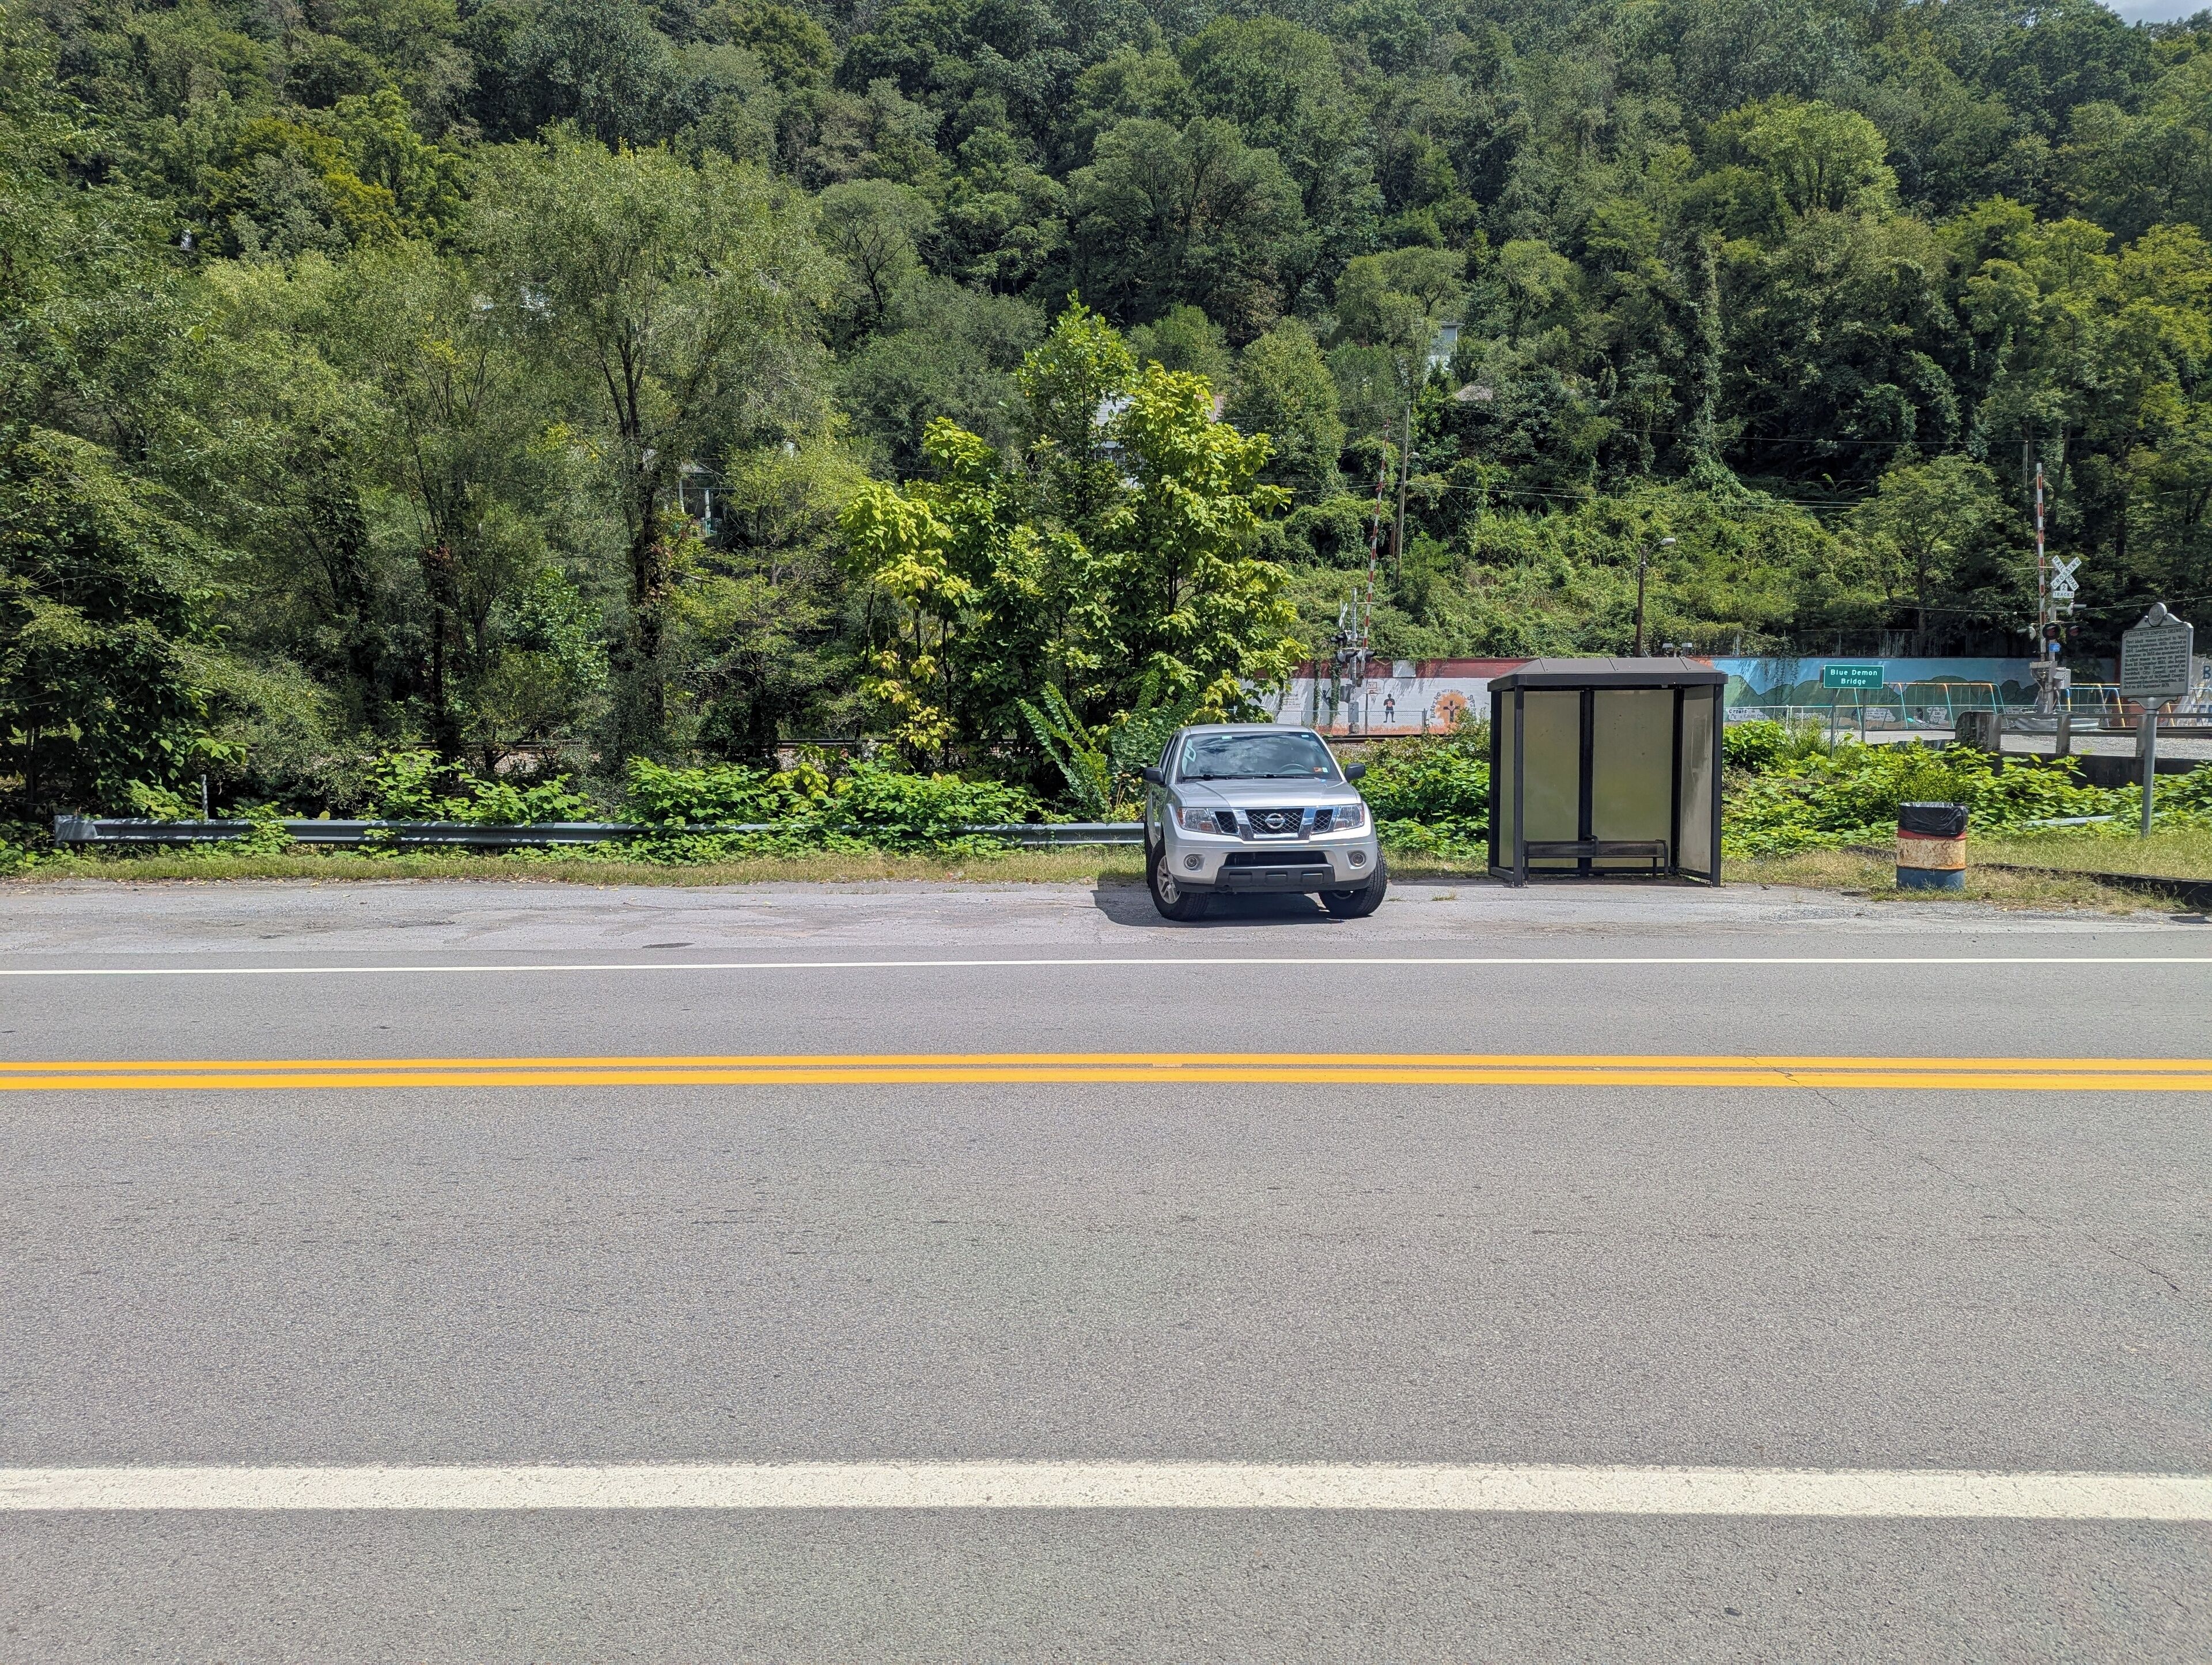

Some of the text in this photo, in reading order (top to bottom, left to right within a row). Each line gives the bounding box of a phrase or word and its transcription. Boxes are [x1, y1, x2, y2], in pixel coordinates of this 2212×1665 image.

[2053, 559, 2080, 587] CROSSING
[2054, 557, 2077, 589] RAIL ROAD
